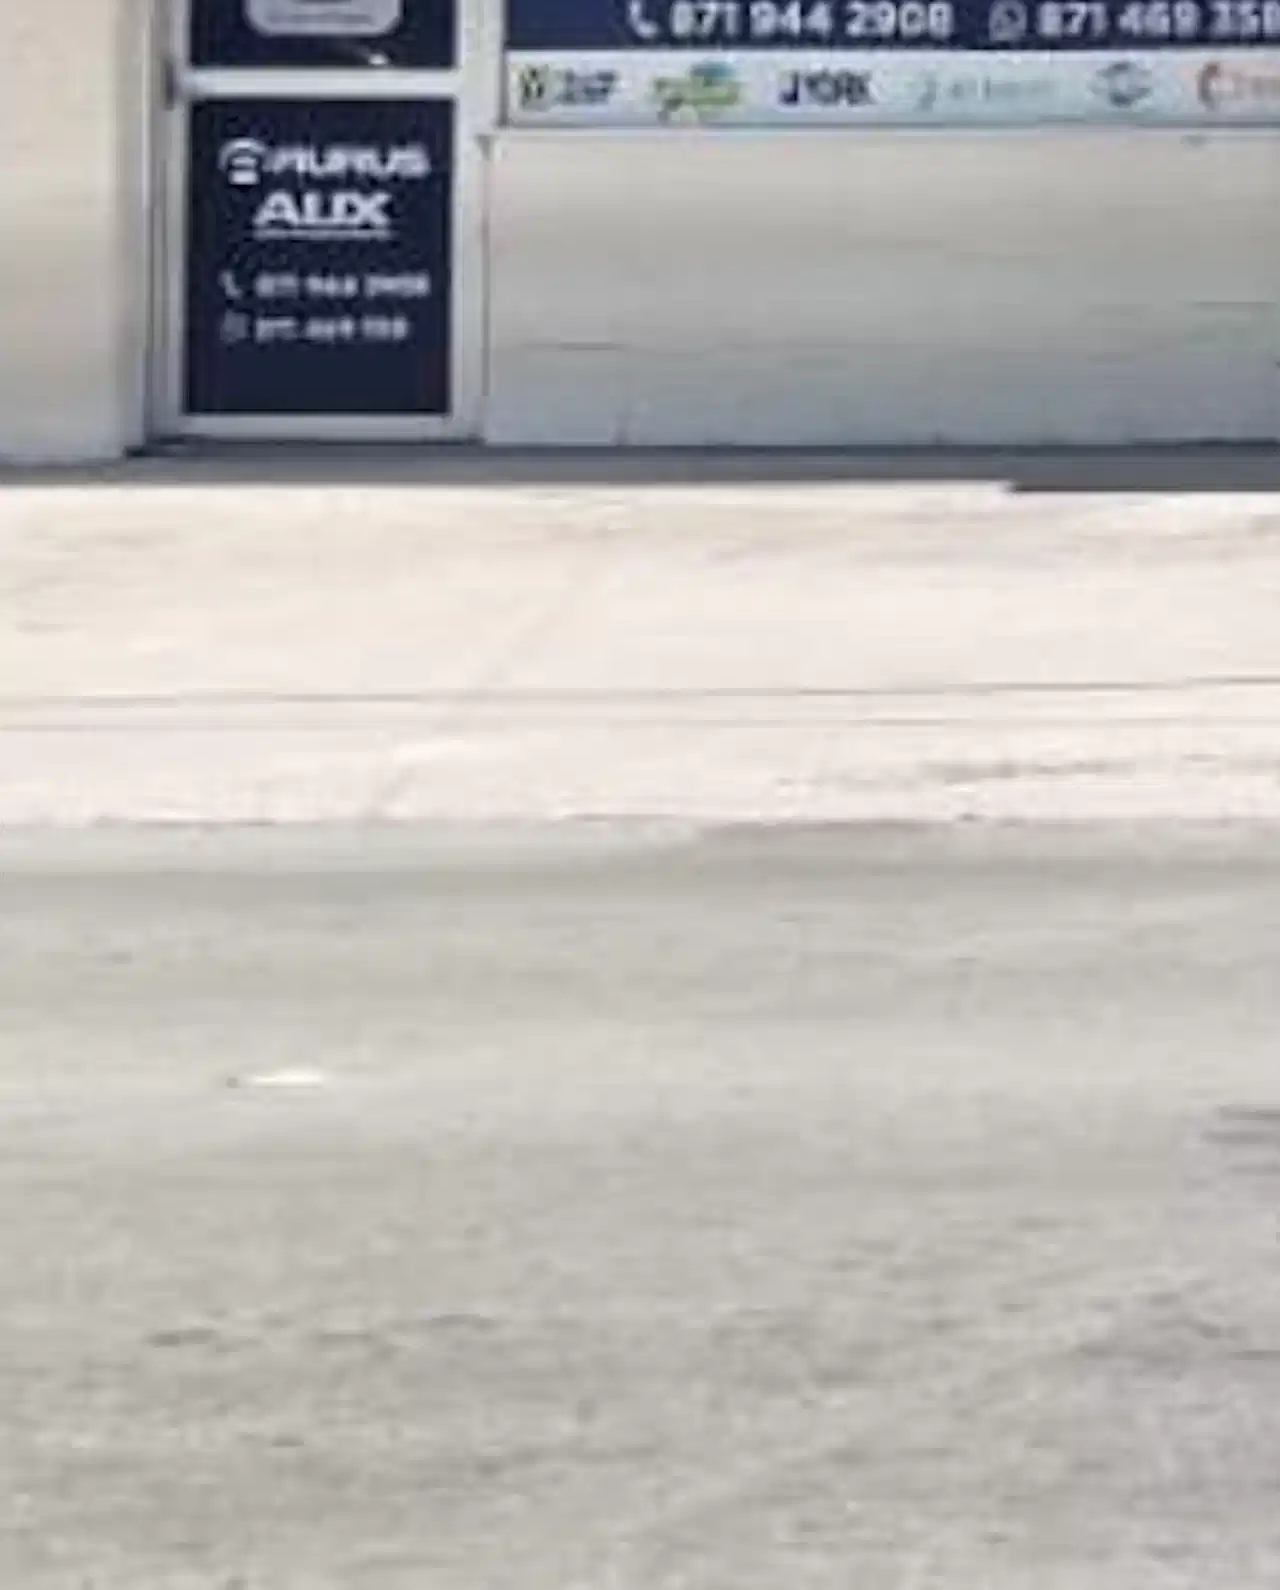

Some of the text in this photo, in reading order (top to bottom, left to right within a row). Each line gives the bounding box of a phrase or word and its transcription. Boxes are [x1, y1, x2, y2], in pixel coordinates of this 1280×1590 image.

[670, 0, 954, 38] 871 944 2908
[251, 191, 392, 226] AUX
